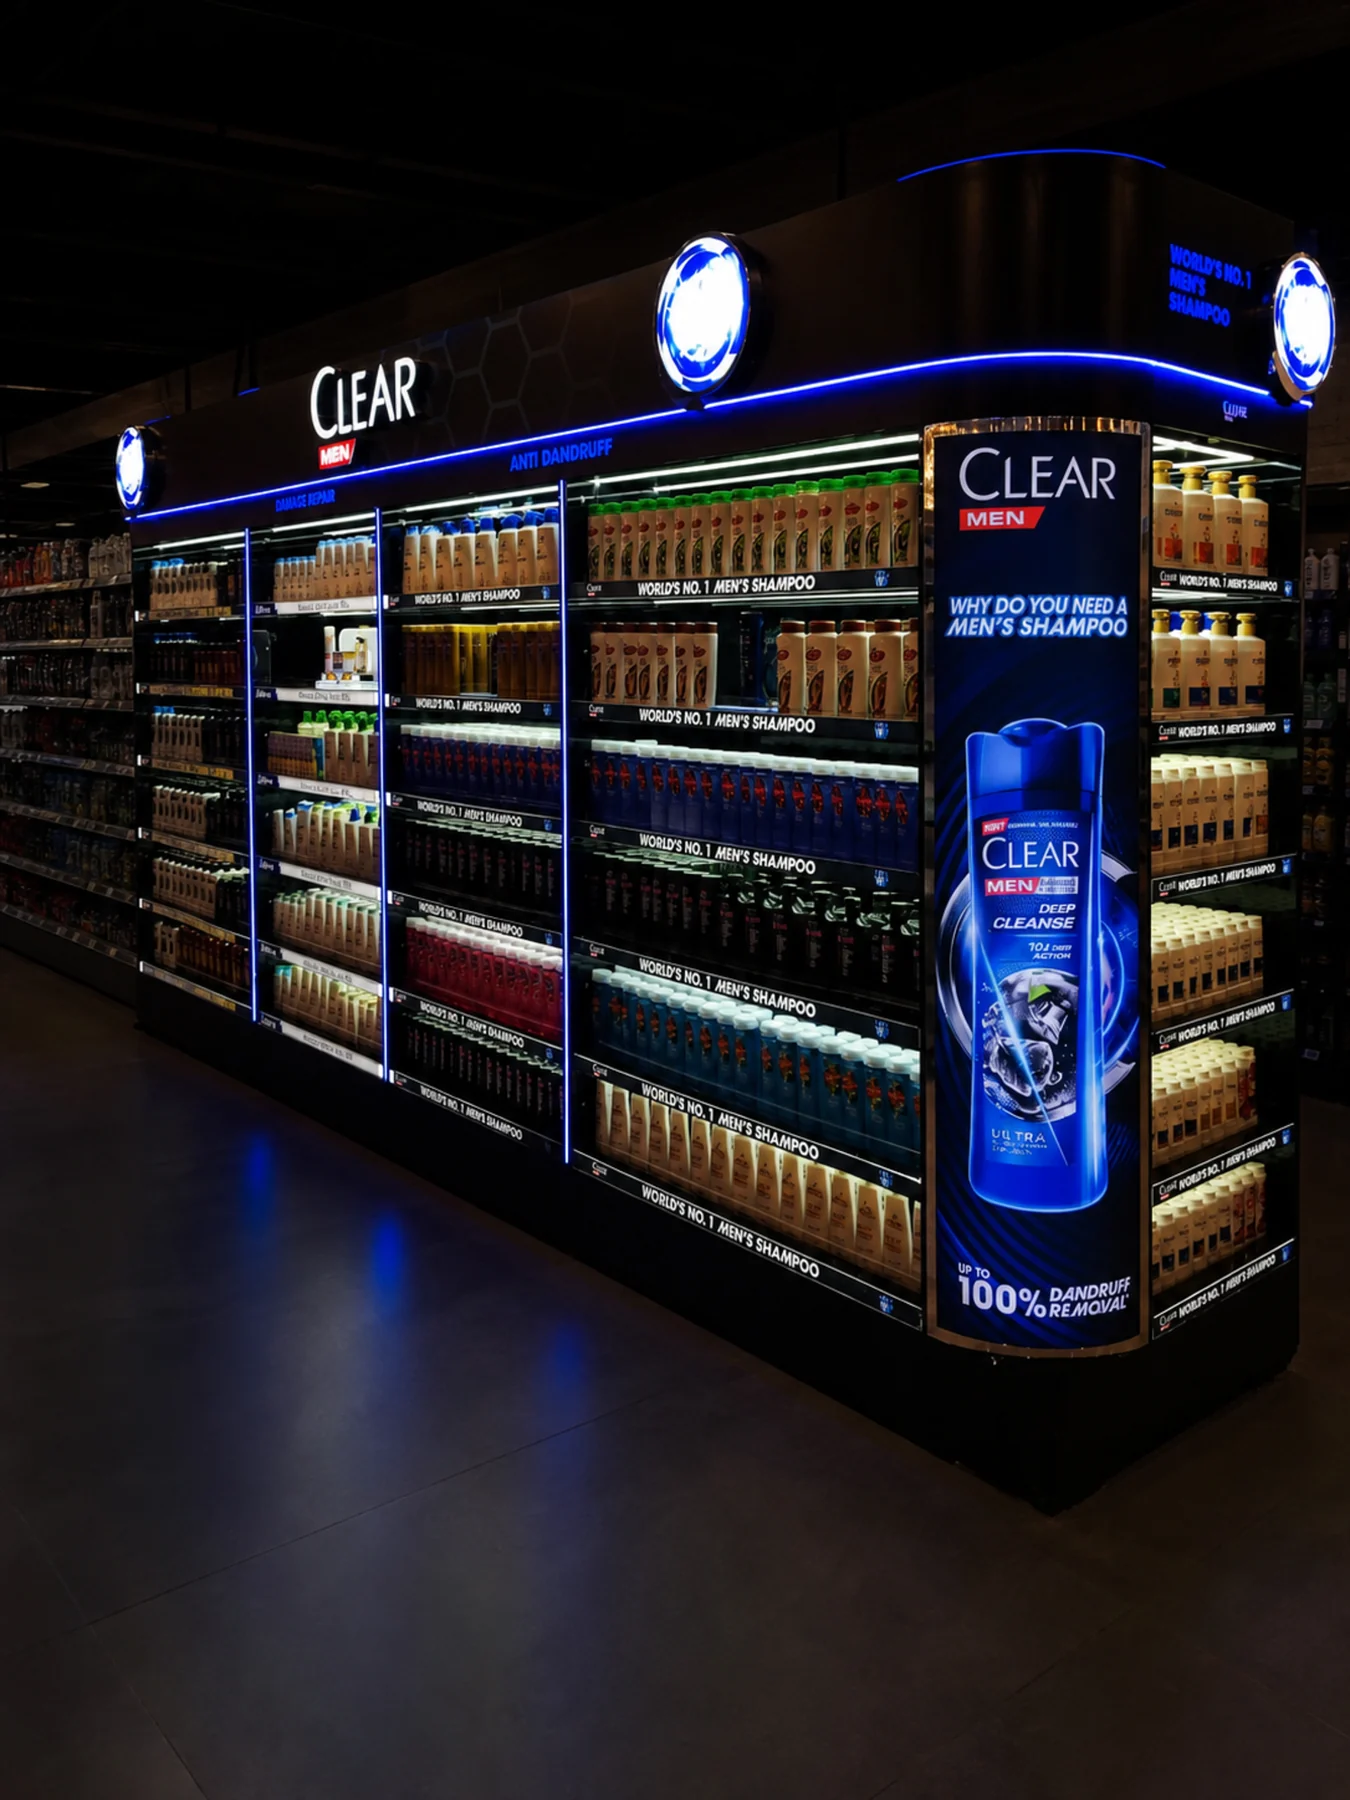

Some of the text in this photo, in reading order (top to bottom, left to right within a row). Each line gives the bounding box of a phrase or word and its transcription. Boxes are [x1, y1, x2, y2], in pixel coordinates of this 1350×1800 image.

[1170, 243, 1251, 290] WORLD'S NO. 1
[1169, 267, 1206, 297] MEN'S
[1169, 291, 1231, 327] SHAMPOO
[310, 357, 417, 439] CLEAR
[320, 443, 350, 466] MEN
[510, 438, 613, 472] ANTI DANDRUFF
[959, 447, 1116, 501] CLEAR
[967, 511, 1025, 526] MEN
[637, 575, 815, 596] WORLD'S NO. 1 MEN'S SHAMPOO
[949, 596, 1128, 615] WHY DO YOU NEED A
[946, 616, 1128, 636] MEN'S SHAMPOO
[639, 708, 815, 734] WORLD'S NO. 1 MEN'S SHAMPOO
[639, 834, 815, 875] WORLD'S NO. 1 MEN'S SHAMPOO
[982, 836, 1080, 870] CLEAR
[987, 879, 1033, 892] MEN
[1039, 903, 1076, 914] DEEP
[993, 917, 1075, 929] CLEANSE
[1032, 952, 1072, 960] ACTION
[639, 958, 815, 1018] WORLD'S NO. 1 MEN'S SHAMPOO
[641, 1082, 819, 1161] WORLD'S NO. 1 MEN'S SHAMPOO
[641, 1185, 819, 1278] WORLD'S NO. 1 MEN'S SHAMPOO
[958, 1262, 991, 1279] UP TO
[958, 1275, 1047, 1318] 100%
[1049, 1276, 1131, 1302] DANDRUFF
